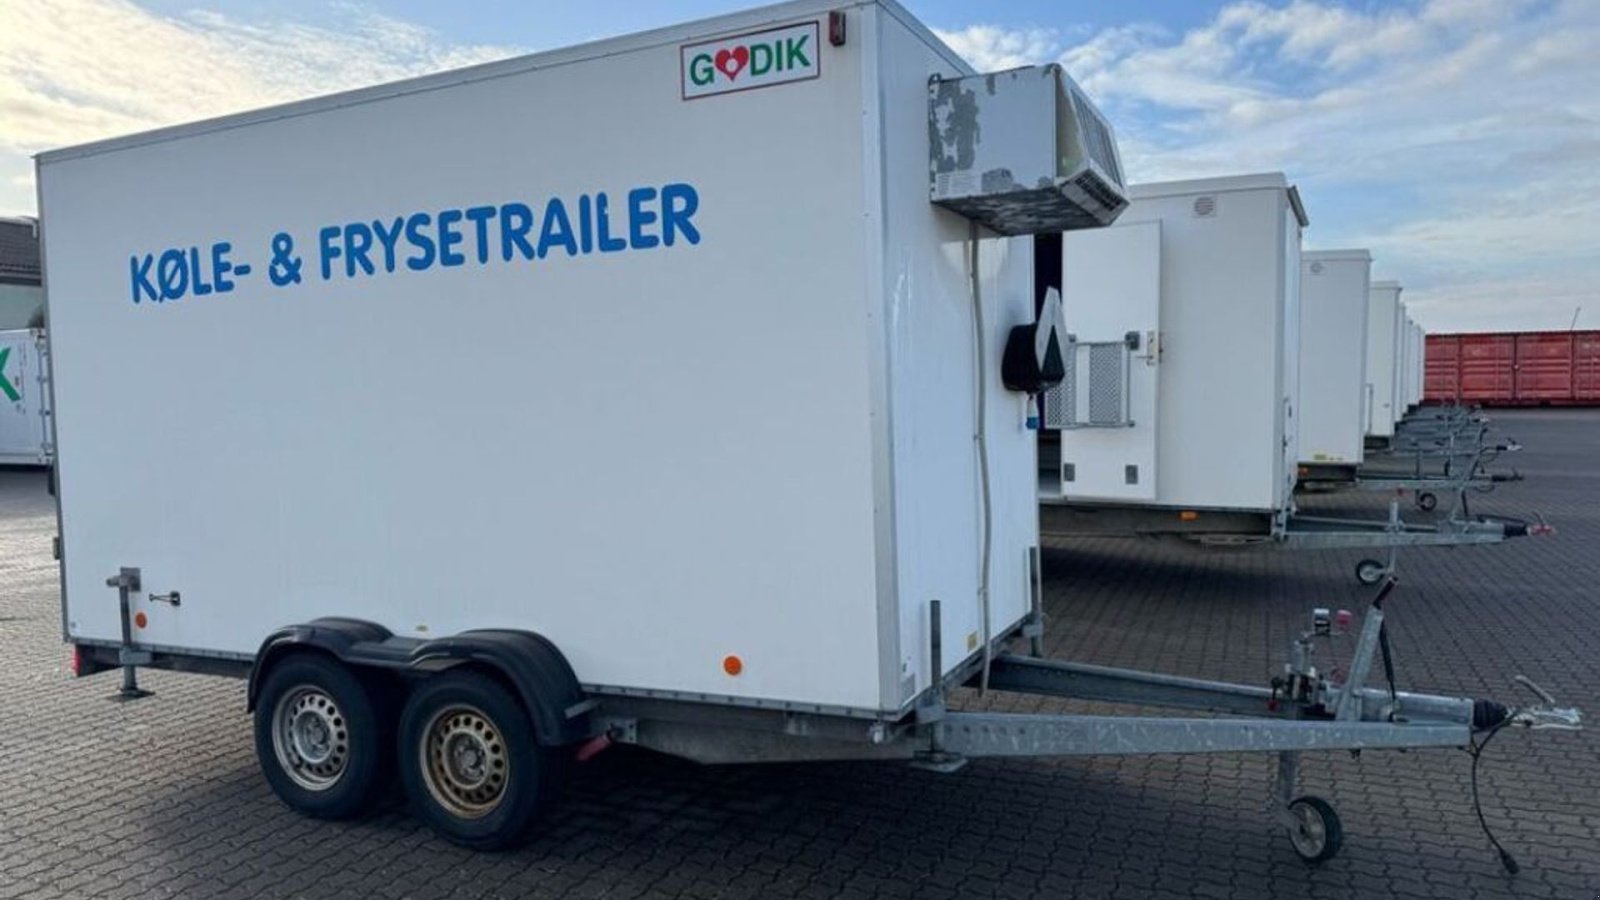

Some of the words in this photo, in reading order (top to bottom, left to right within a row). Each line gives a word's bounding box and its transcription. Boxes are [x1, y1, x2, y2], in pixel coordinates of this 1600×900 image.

[130, 241, 251, 303] KØLE-
[268, 231, 302, 287] &
[319, 182, 702, 280] FRYSETRAILER
